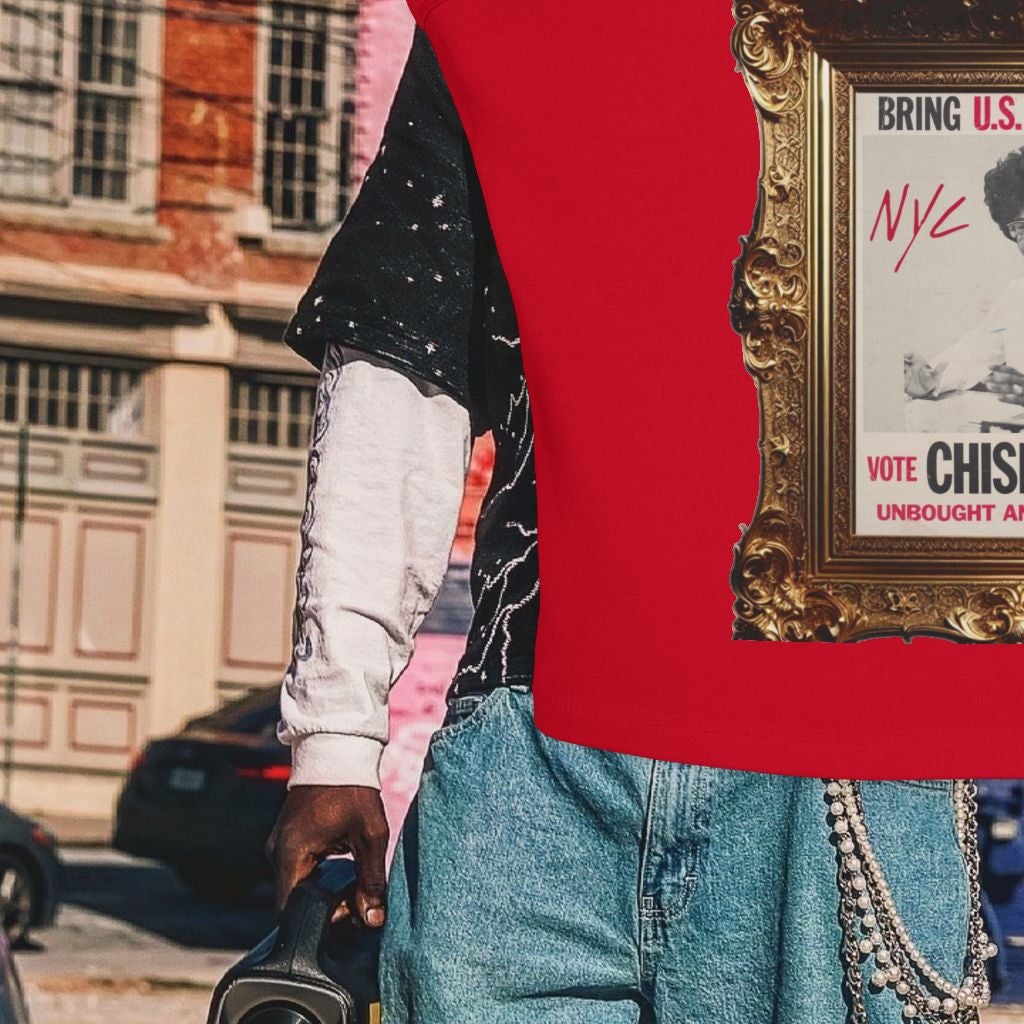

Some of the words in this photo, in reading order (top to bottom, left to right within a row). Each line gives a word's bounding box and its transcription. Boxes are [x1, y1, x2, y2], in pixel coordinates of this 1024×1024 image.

[878, 96, 960, 130] BRING
[973, 95, 1022, 130] U.S.
[869, 183, 970, 273] NYC
[867, 456, 918, 482] VOTE
[876, 504, 997, 522] UNBOUGHT
